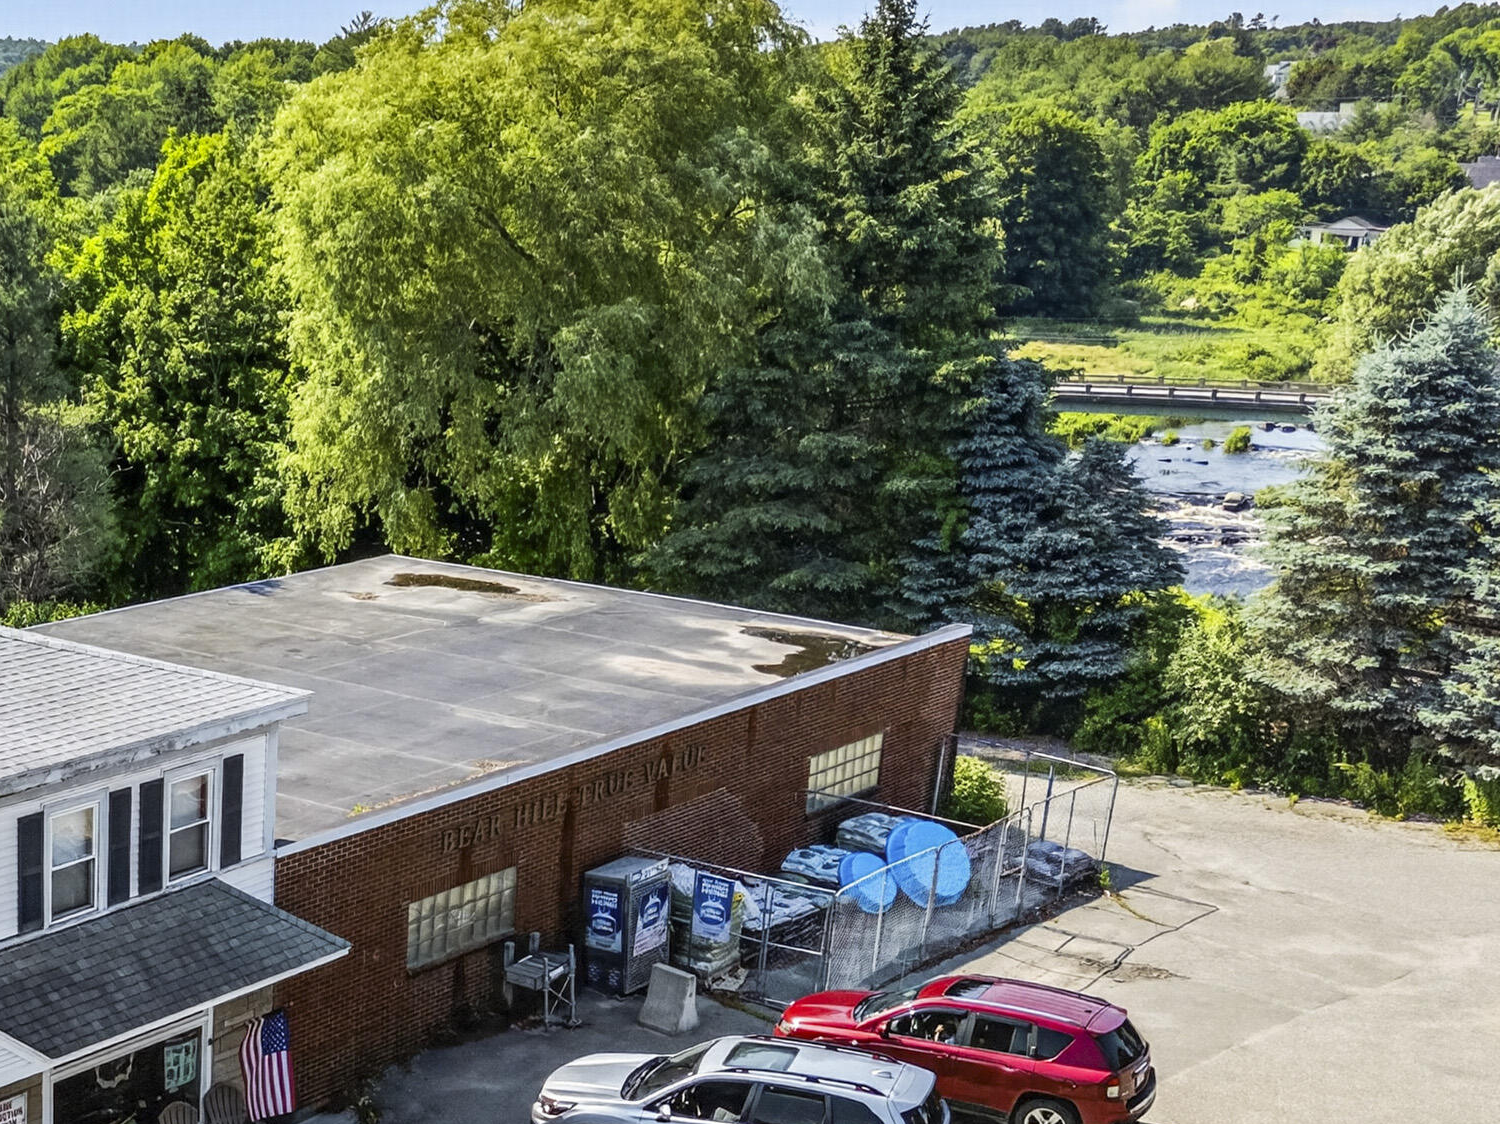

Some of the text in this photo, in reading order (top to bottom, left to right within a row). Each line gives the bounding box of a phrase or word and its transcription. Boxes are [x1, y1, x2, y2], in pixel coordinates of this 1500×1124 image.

[441, 815, 501, 855] BEAR
[579, 769, 634, 806] TRUE
[644, 744, 706, 784] VALUE
